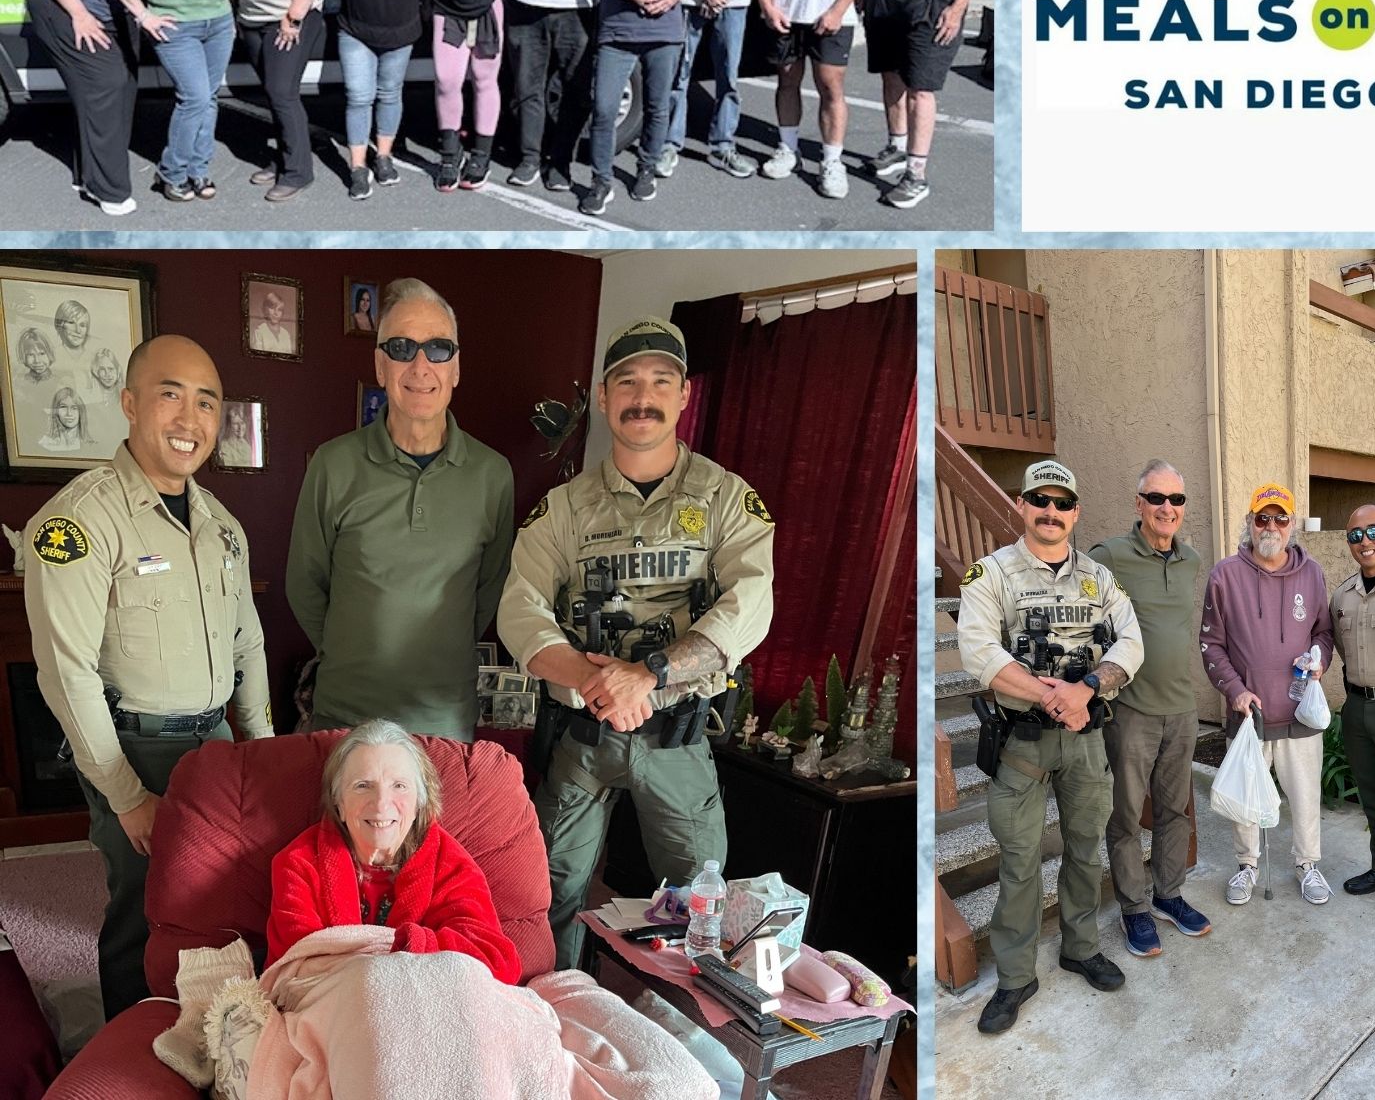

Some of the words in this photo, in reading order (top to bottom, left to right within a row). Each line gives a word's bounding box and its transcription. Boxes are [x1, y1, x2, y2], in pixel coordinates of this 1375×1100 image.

[1034, 472, 1070, 485] SHERIFF
[35, 526, 45, 542] SAN
[45, 519, 67, 530] DIEGO
[66, 524, 86, 554] COUNTY
[40, 546, 71, 561] SHERIFF
[595, 550, 691, 580] SHERIFF
[1031, 605, 1094, 623] SHERIFF
